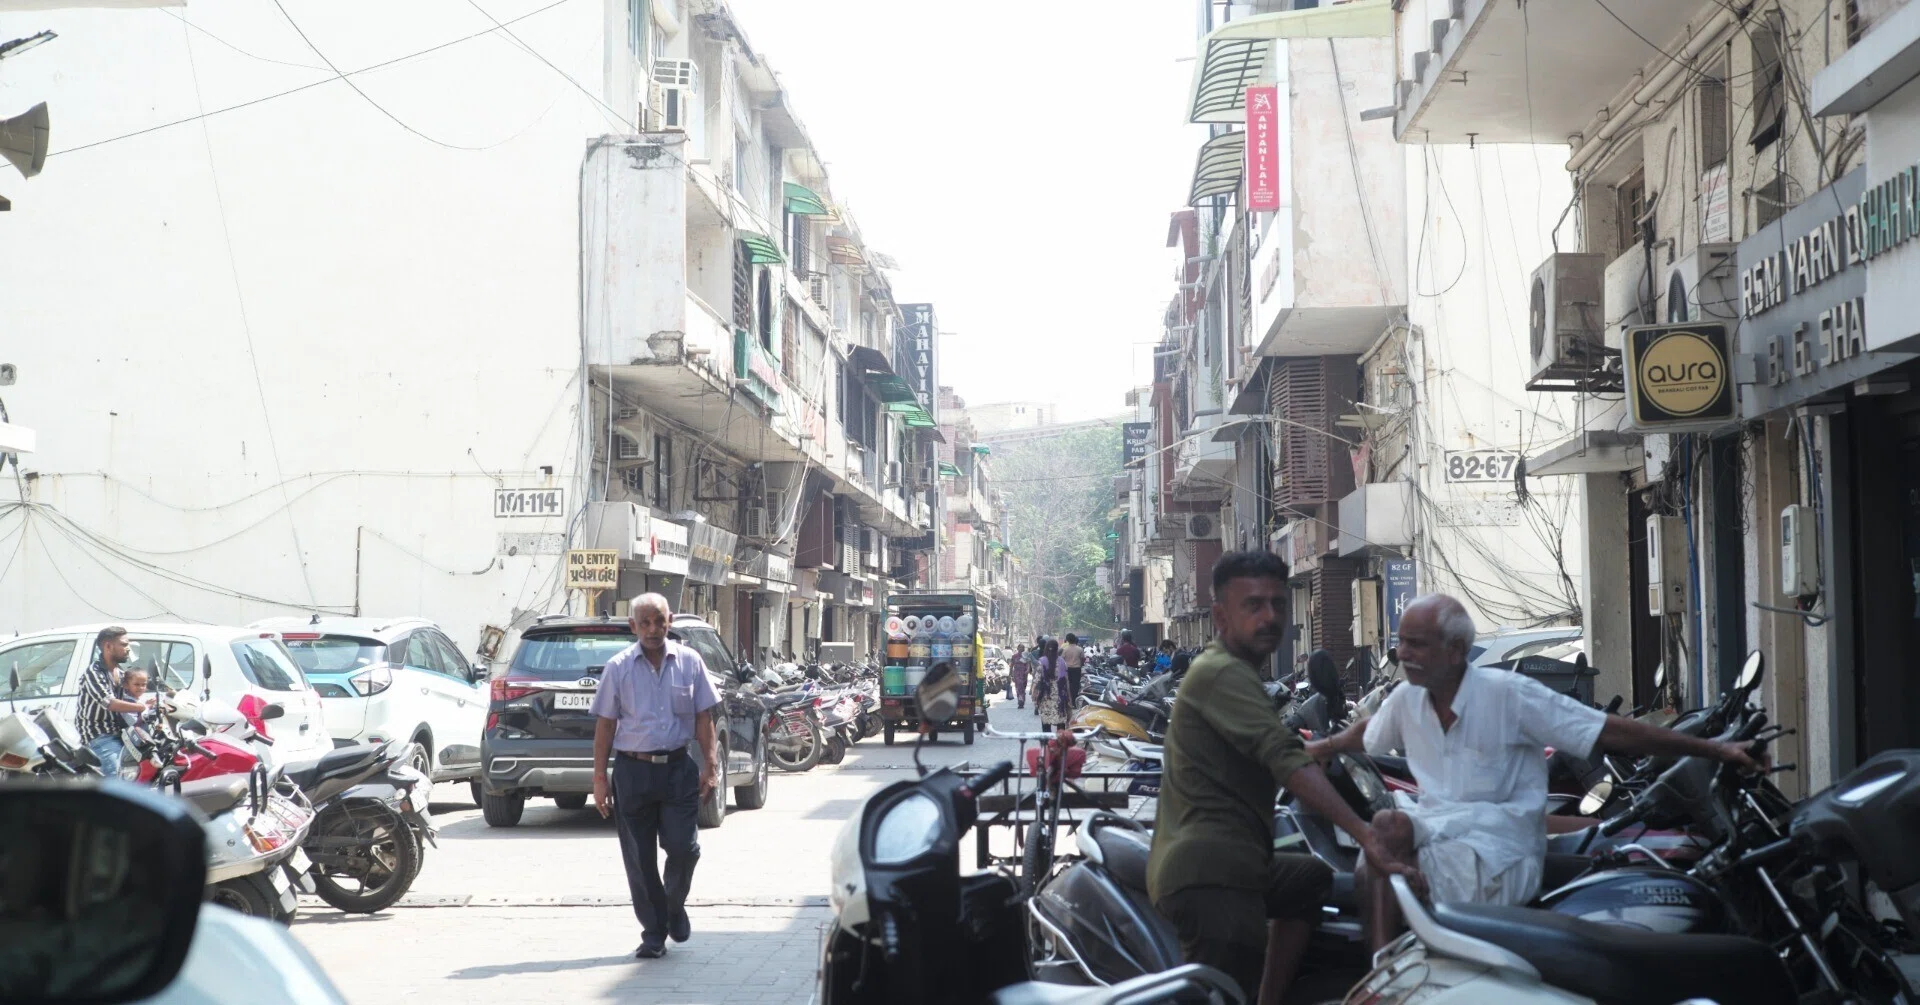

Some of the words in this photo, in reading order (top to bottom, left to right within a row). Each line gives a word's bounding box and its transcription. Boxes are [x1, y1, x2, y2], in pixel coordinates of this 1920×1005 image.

[1258, 115, 1267, 187] ANJANILAL
[1860, 173, 1901, 261] SHAH
[1743, 254, 1783, 319] RSM
[1786, 219, 1841, 295] YARN
[916, 312, 929, 405] MAHAVIR
[1648, 362, 1716, 383] aura
[571, 554, 584, 565] NO
[586, 554, 616, 565] ENTRY
[562, 696, 595, 706] GJ01K
